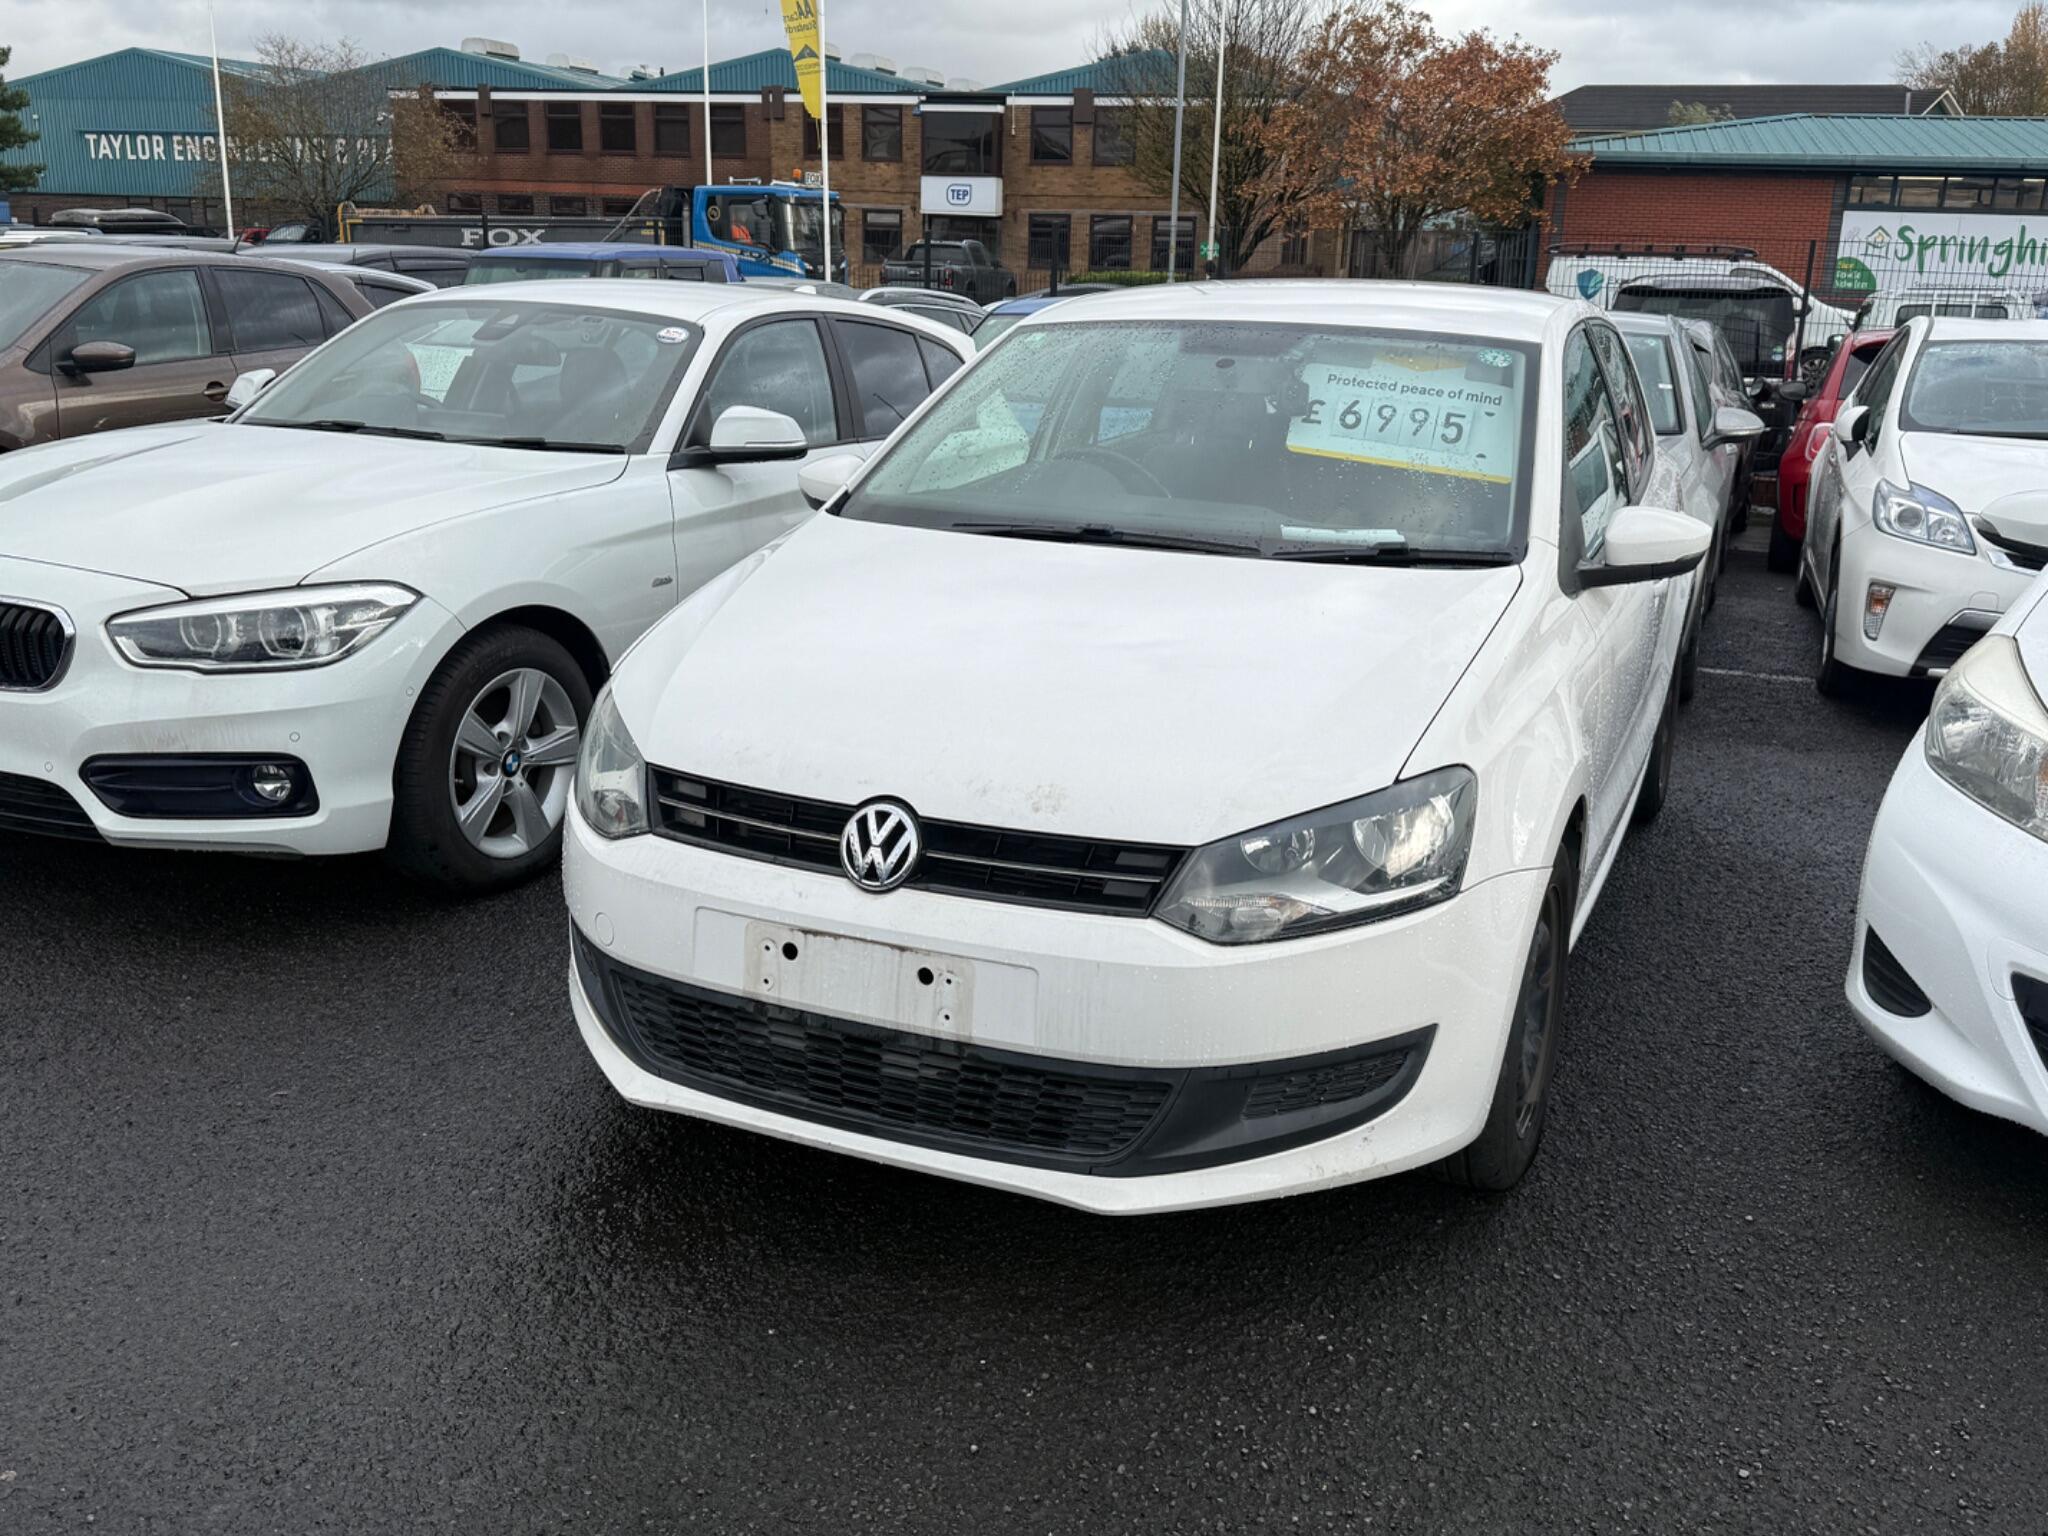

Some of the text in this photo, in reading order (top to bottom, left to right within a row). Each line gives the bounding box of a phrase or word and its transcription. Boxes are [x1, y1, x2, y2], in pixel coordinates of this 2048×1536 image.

[84, 133, 166, 160] TAYLOR
[950, 188, 969, 201] TEP
[461, 228, 545, 246] FOX
[1327, 373, 1503, 406] Protected peace of mind
